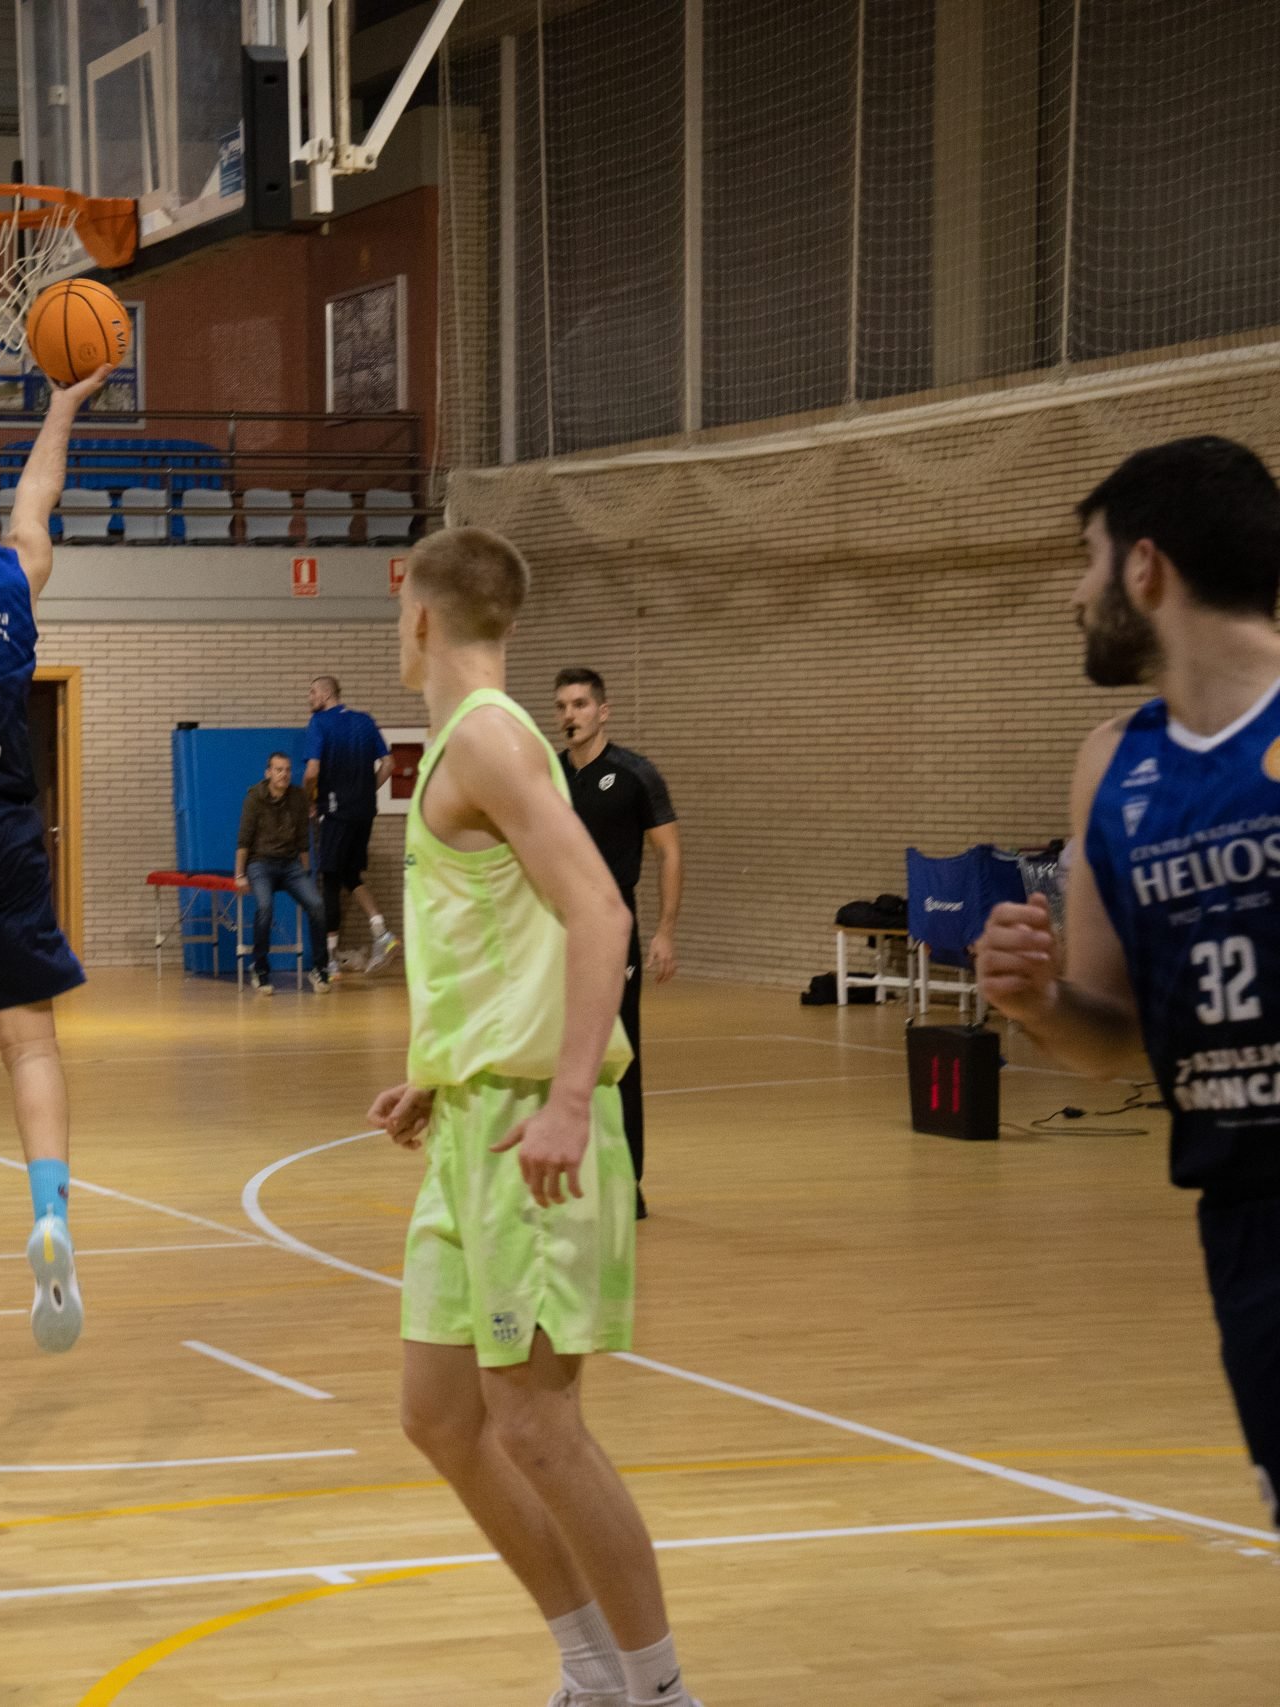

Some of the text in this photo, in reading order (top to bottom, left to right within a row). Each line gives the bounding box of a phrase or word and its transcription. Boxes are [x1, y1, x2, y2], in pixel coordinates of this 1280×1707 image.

[1132, 833, 1280, 906] HELIOS
[1190, 935, 1262, 1025] 32
[929, 1056, 961, 1114] 11
